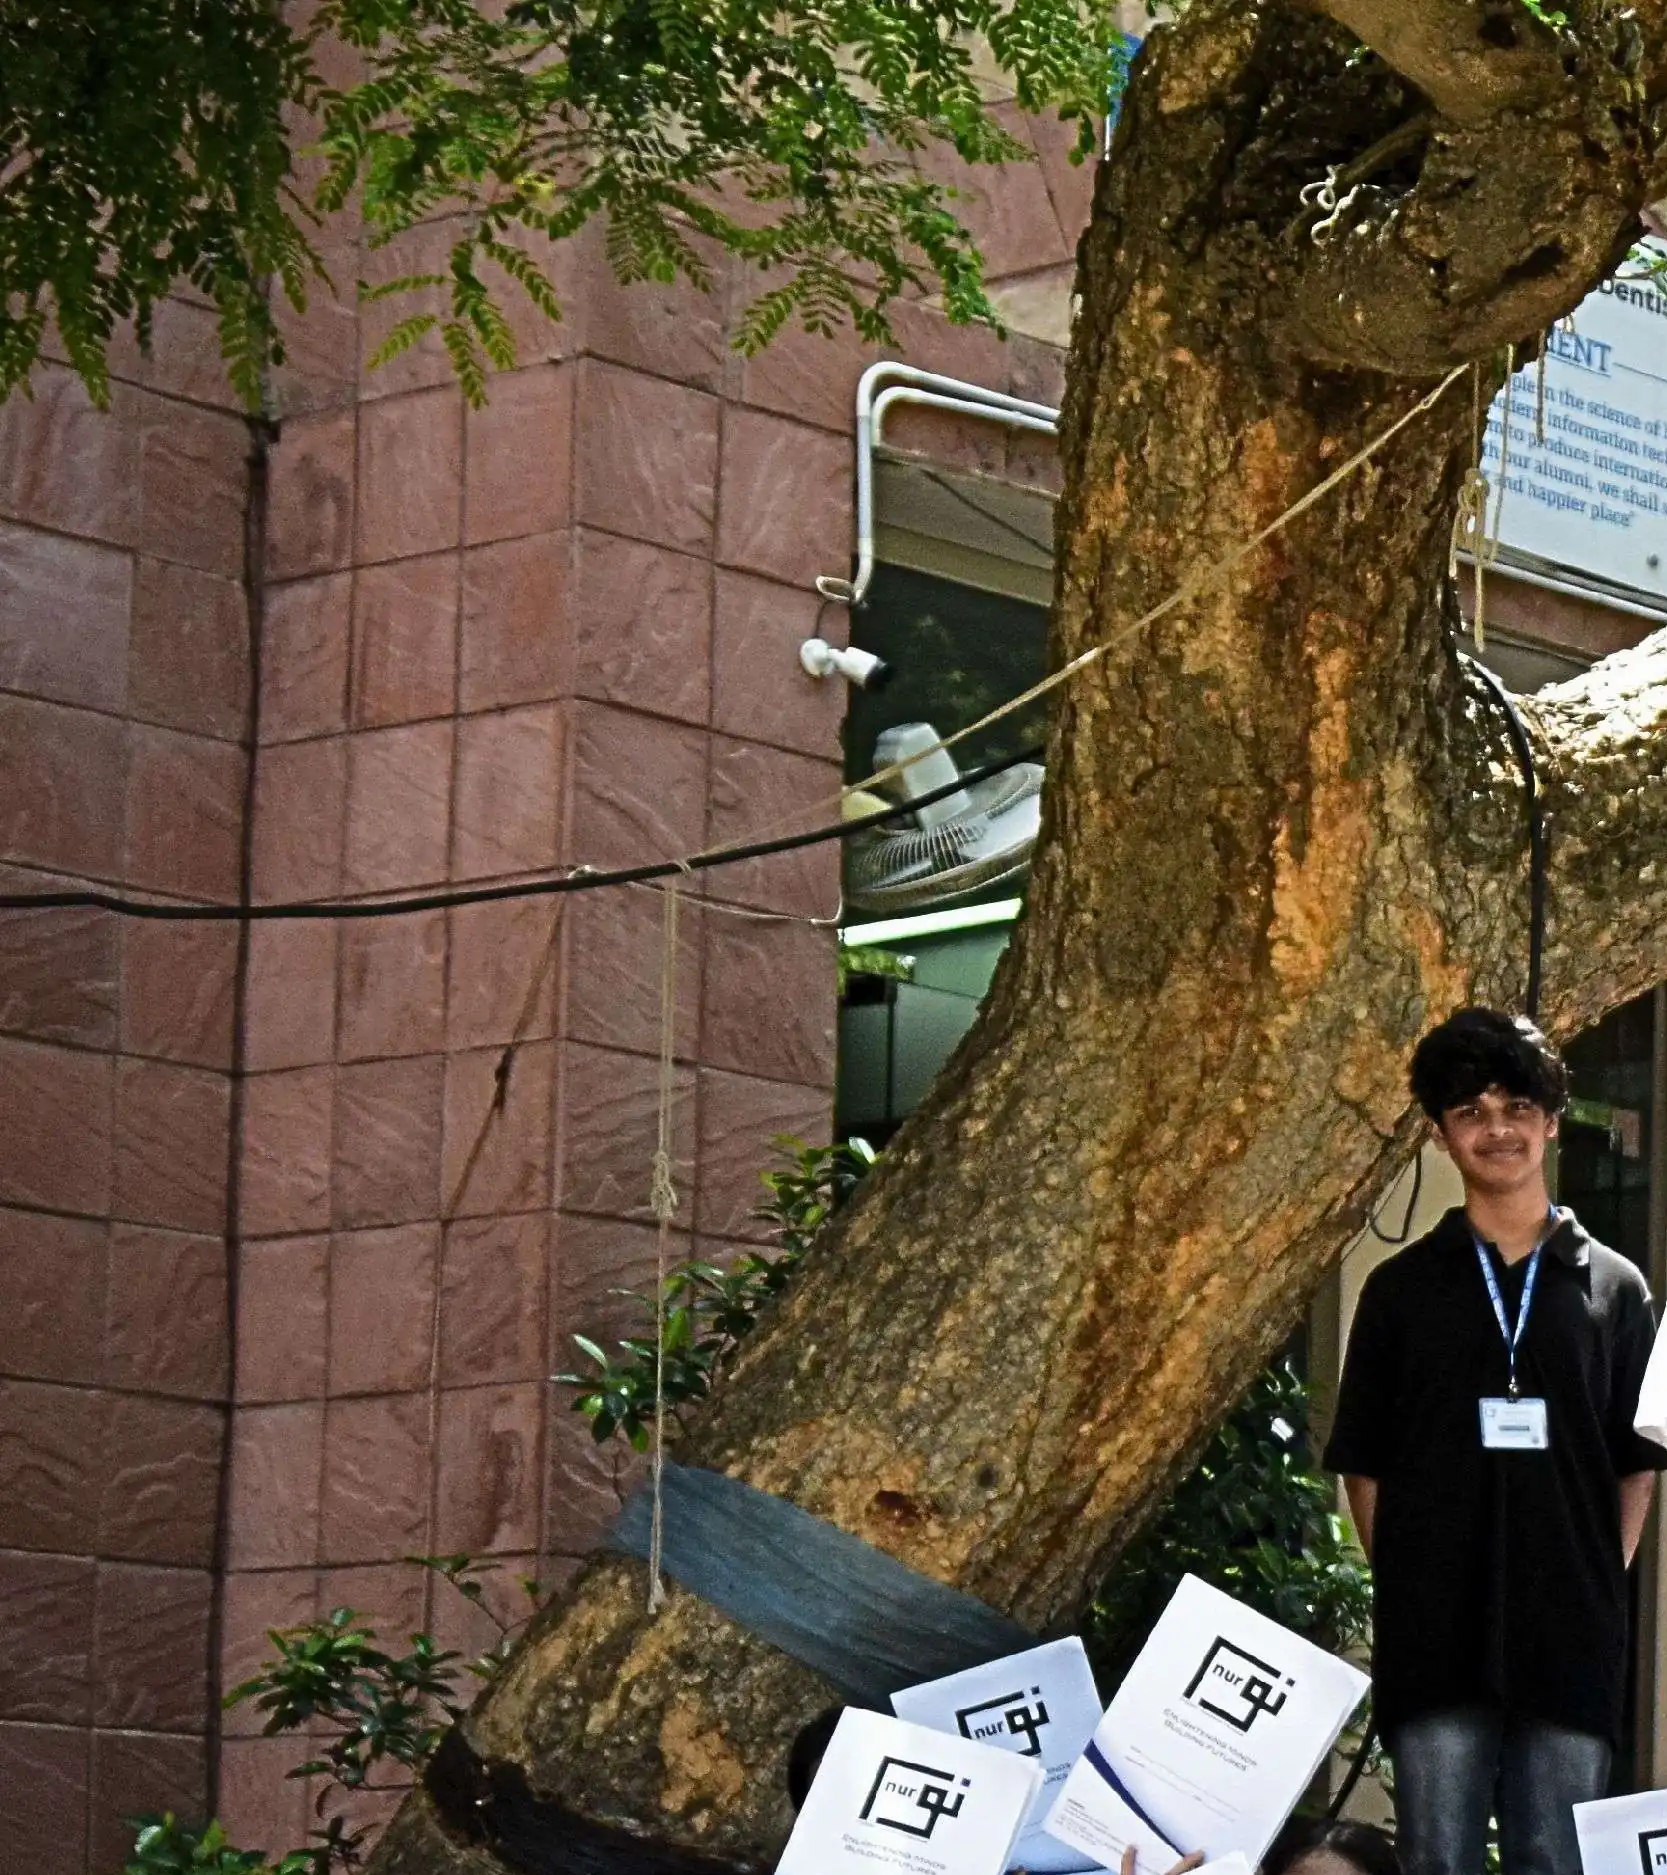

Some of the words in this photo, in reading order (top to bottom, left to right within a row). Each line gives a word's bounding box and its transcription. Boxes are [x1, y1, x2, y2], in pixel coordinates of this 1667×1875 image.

[1587, 400, 1641, 431] science
[1644, 420, 1662, 437] of
[1547, 408, 1639, 456] information
[1623, 485, 1659, 512] shall
[1213, 1663, 1245, 1688] nur
[974, 1721, 1004, 1738] nur
[884, 1780, 917, 1799] nur
